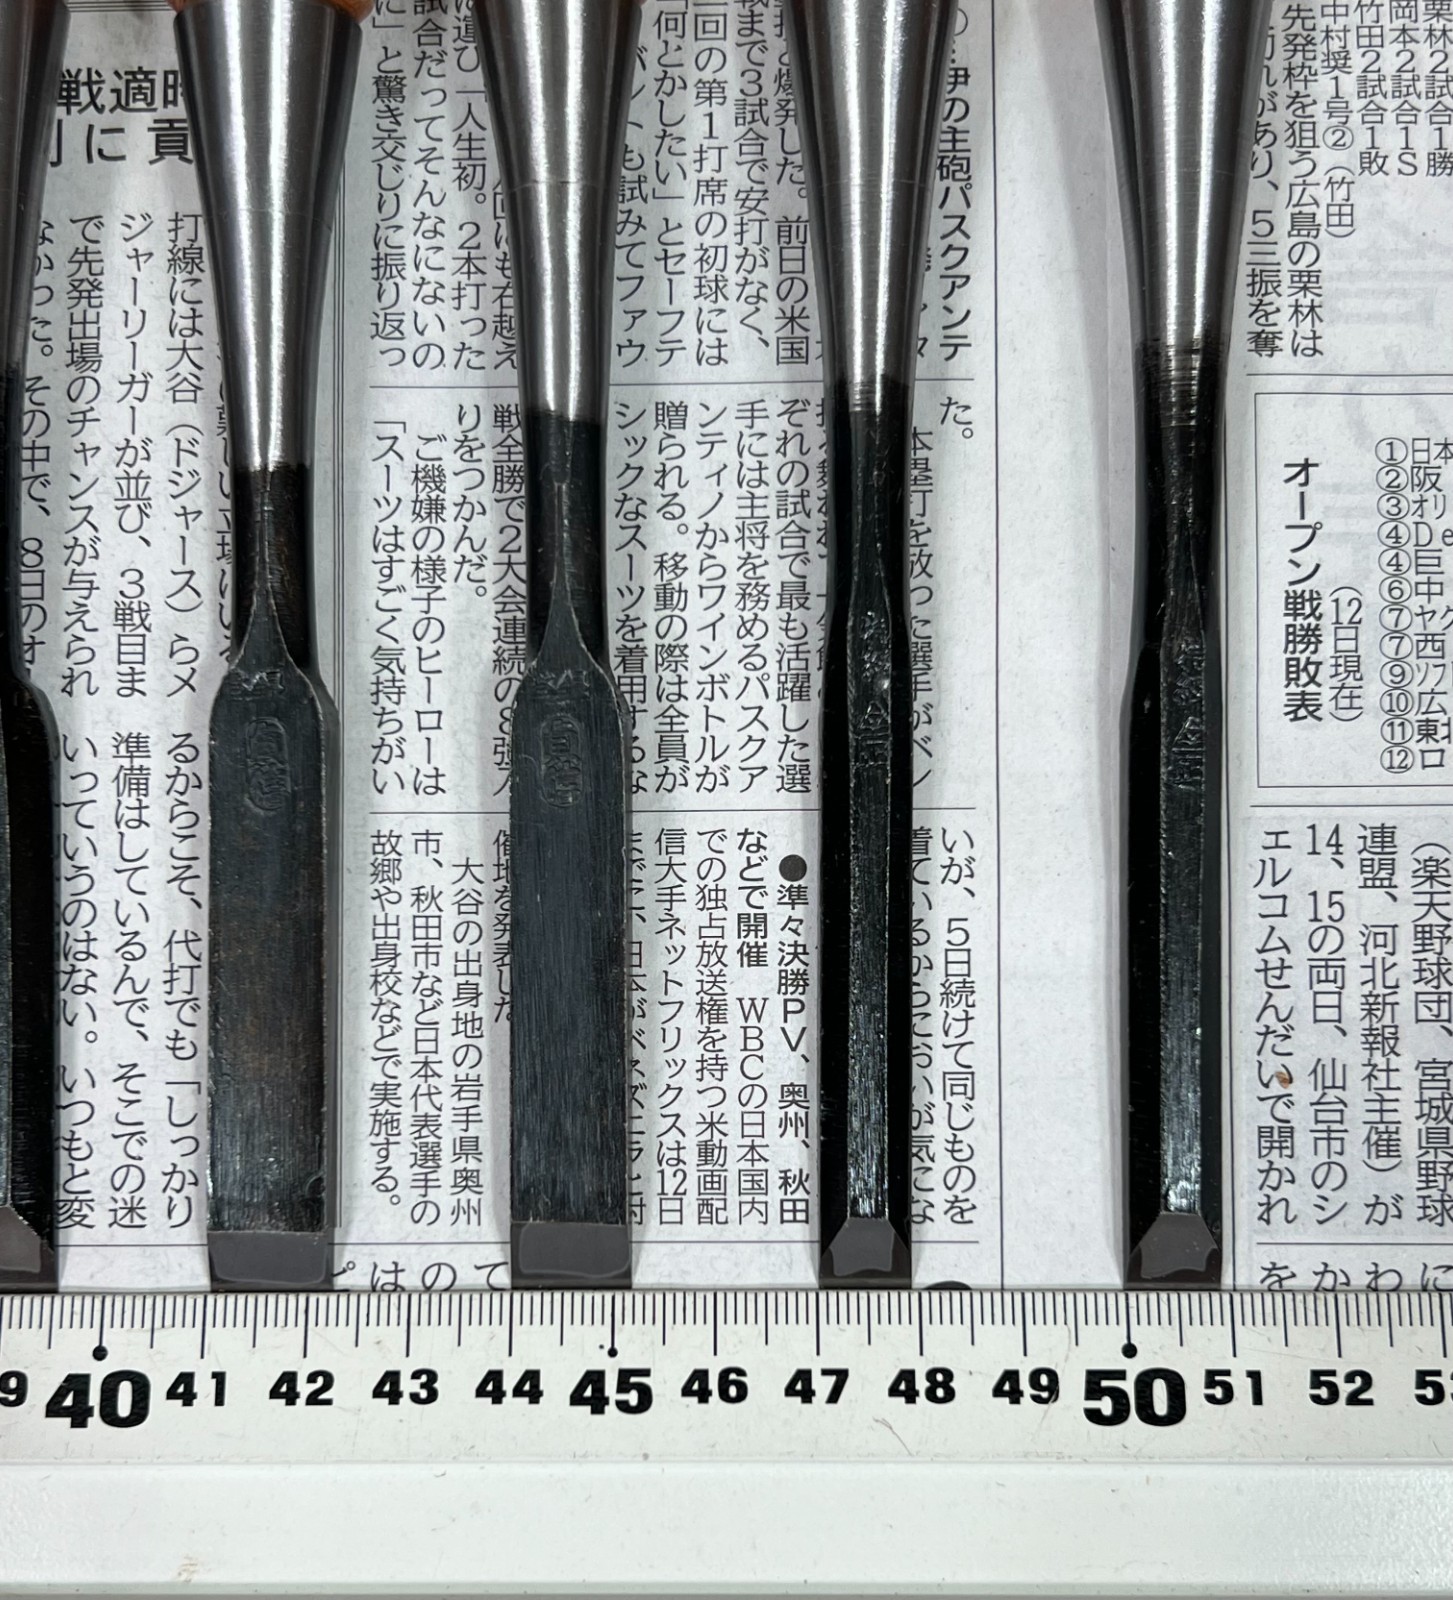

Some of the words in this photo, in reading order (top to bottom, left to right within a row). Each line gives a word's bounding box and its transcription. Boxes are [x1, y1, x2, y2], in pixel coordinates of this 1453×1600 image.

[50, 117, 194, 167] に貢
[1246, 26, 1283, 358] があり、5三振を奪
[1282, 4, 1325, 357] 先発枠を狙う広島の栗林は
[1353, 0, 1391, 177] 竹田2試合1敗
[1388, 0, 1422, 177] 岡本2試合1S
[1422, 0, 1453, 177] 栗林2試合1勝
[61, 214, 104, 698] で先発出場のチャンスが与えられ
[113, 212, 154, 698] ジャーリーガーが並び、3戦目ま
[165, 211, 206, 698] 打線には大谷（ドジャース）らメ
[370, 420, 407, 796] 「スーツはすごく気持ちがい
[453, 404, 488, 598] りをつかんだ。
[653, 400, 690, 794] 贈られる。移動の際は全員が
[694, 402, 730, 794] ンティノからワインボトルが
[734, 400, 771, 794] 手には主将を務めるパスクア
[774, 398, 812, 794] ぞれの試合で最も活躍した選
[940, 396, 974, 439] た。
[1283, 457, 1324, 723] オープン戦勝敗表
[410, 434, 448, 796] ご機嫌の様子のヒーローは
[1329, 586, 1365, 723] （12日現在）
[1380, 660, 1453, 688] ⑨ソフ
[56, 734, 99, 1230] いっていうのはない。いつもと変
[108, 731, 151, 1229] 準備はしているんで、そこでの迷
[161, 732, 203, 1229] るからこそ、代打でも「しっかり
[369, 829, 402, 1206] 故郷や出身校などで実施する。
[409, 829, 444, 1227] 市、秋田市など日本代表選手の
[450, 857, 485, 1227] 大谷の出身地の岩手県奥州
[653, 827, 688, 1226] 信大手ネットフリックスは12日
[695, 828, 729, 1226] での独占放送権を持つ米動画配
[940, 827, 978, 1225] いが、5日続けて同じものを
[1253, 830, 1298, 1226] エルコムせんだいで開かれ
[1357, 823, 1404, 1226] 連盟、河北新報社主催）が
[1411, 842, 1453, 1227] （楽天野球団、宮城県野球
[45, 1370, 151, 1428] 40
[166, 1371, 227, 1406] 41
[268, 1370, 335, 1406] 42
[371, 1369, 440, 1405] 43
[474, 1369, 544, 1405] 44
[569, 1368, 653, 1414] 45
[681, 1368, 749, 1404] 46
[784, 1368, 850, 1403] 47
[887, 1367, 956, 1404] 48
[991, 1367, 1060, 1404] 49
[1082, 1366, 1187, 1427] 50
[1203, 1369, 1264, 1405] 51
[1308, 1369, 1374, 1405] 52
